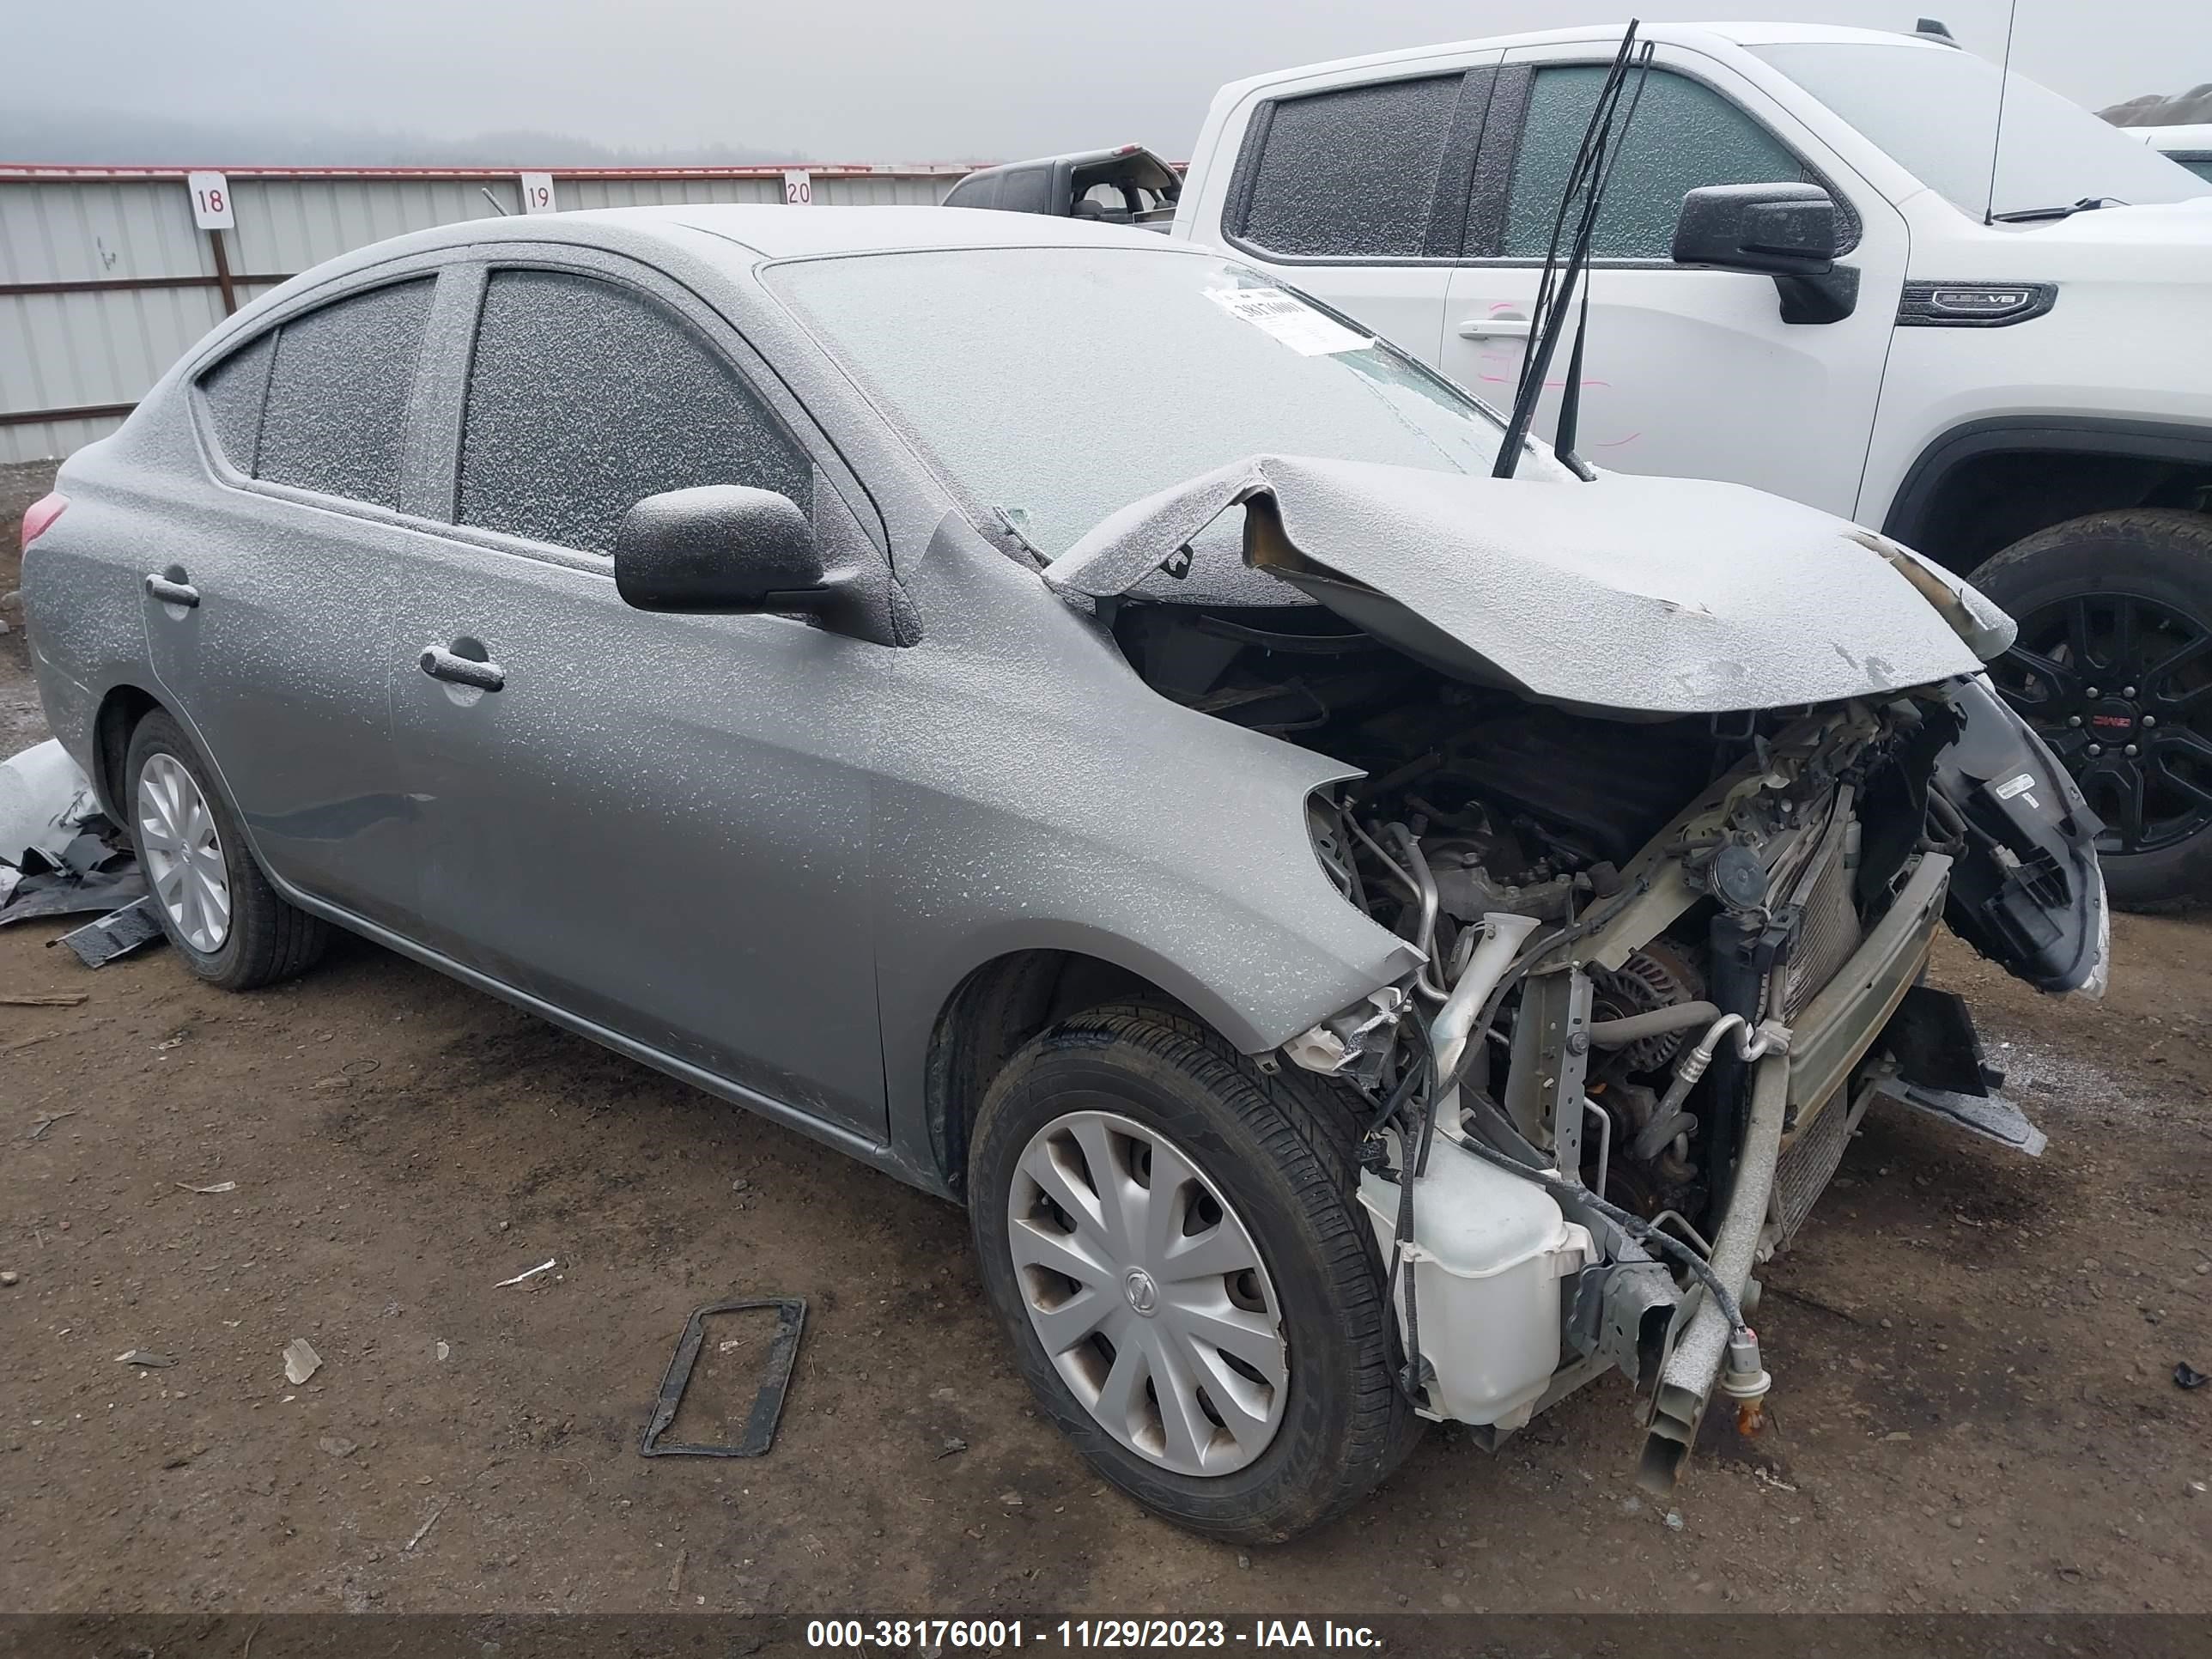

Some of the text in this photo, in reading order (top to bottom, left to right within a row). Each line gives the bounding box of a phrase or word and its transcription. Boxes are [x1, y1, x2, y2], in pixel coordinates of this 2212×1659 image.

[198, 189, 224, 213] 18
[529, 186, 549, 208] 19
[787, 182, 810, 204] 20
